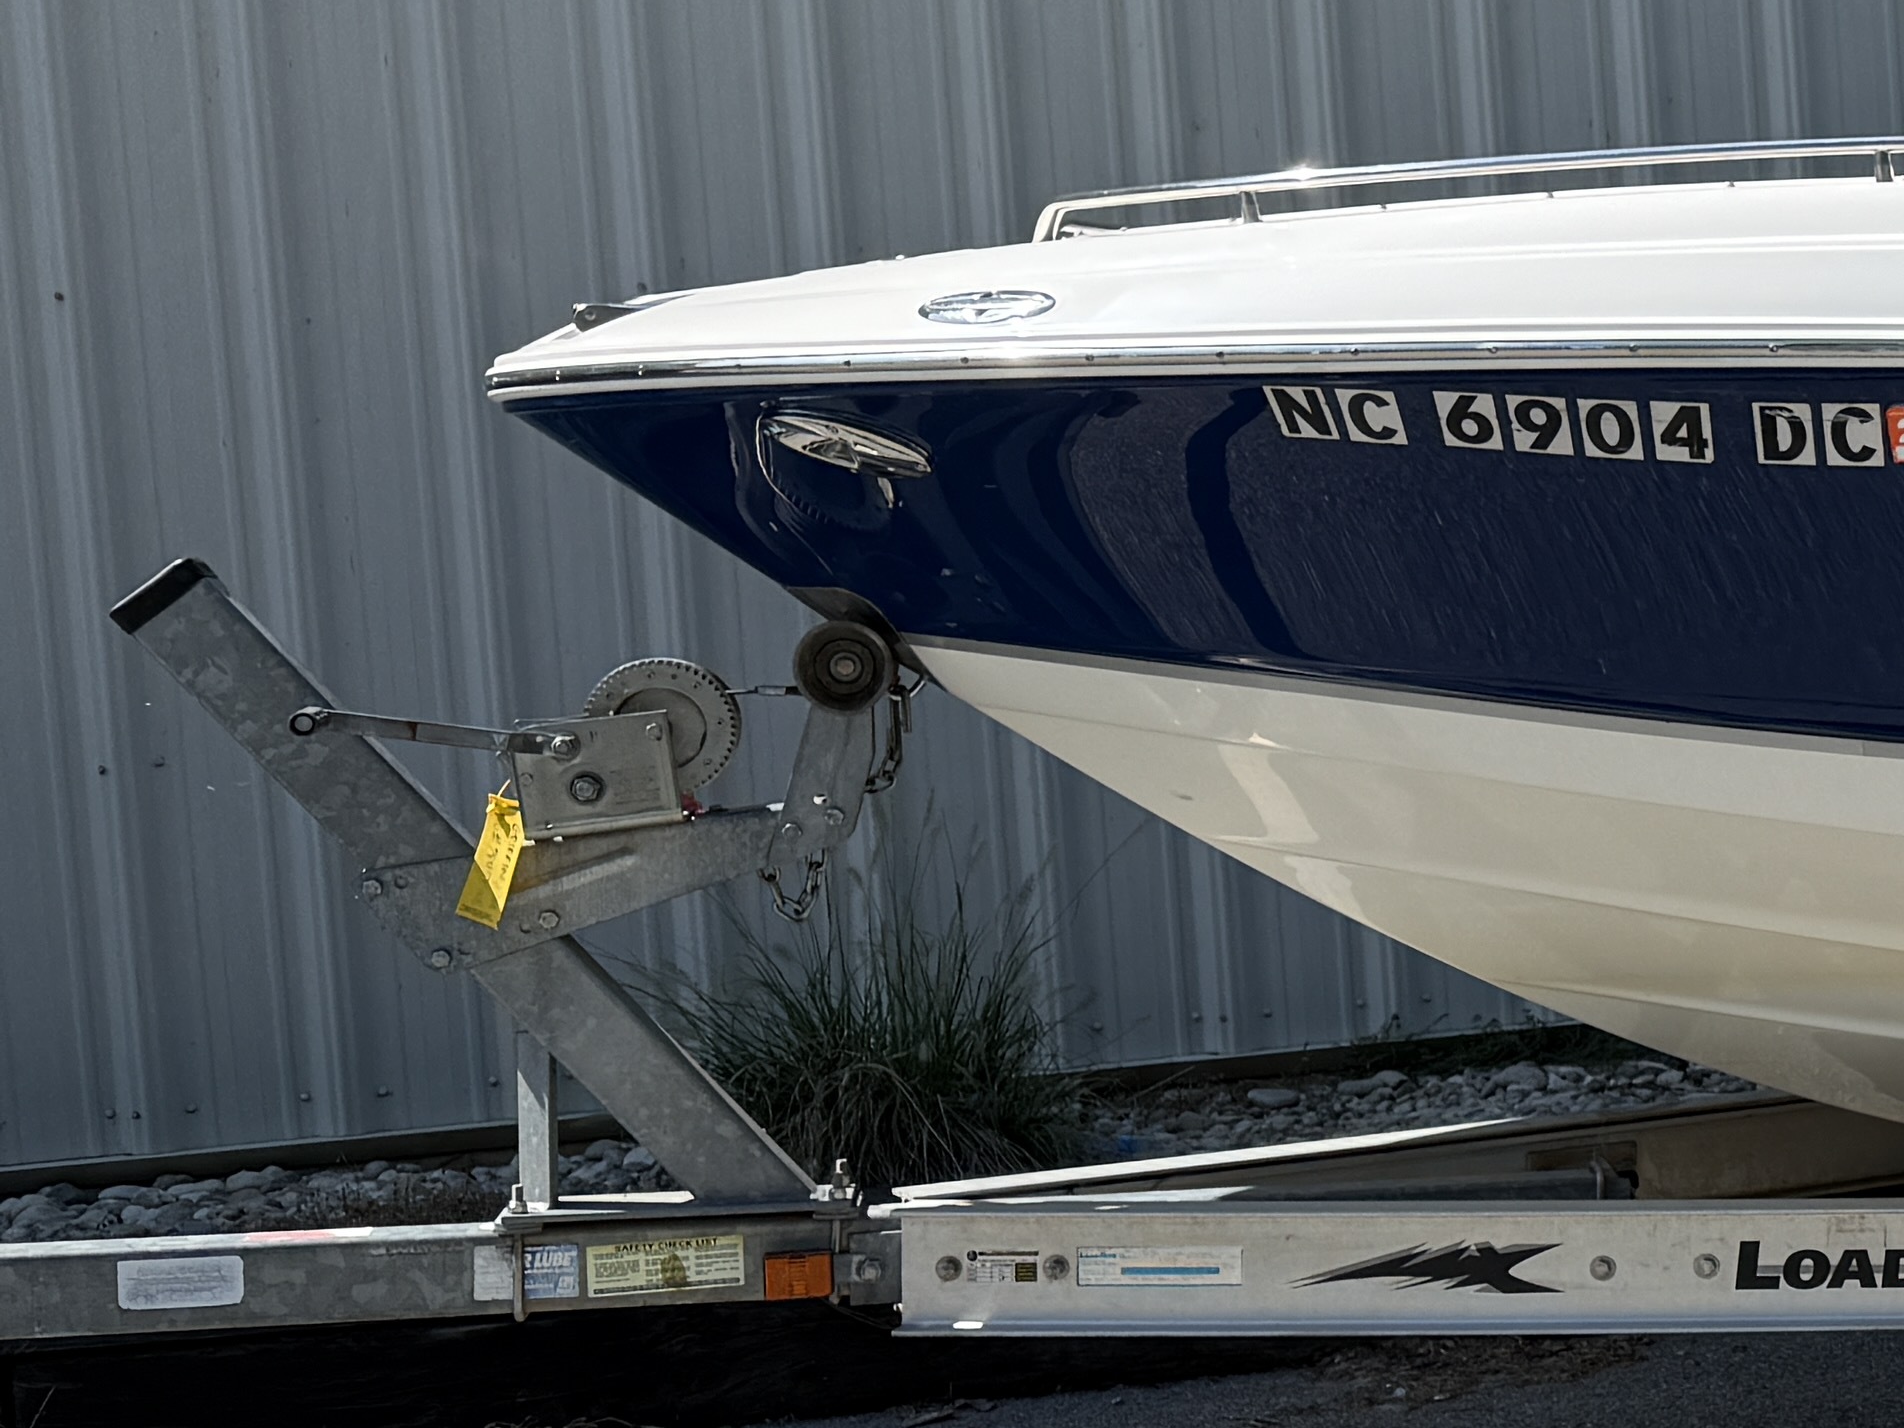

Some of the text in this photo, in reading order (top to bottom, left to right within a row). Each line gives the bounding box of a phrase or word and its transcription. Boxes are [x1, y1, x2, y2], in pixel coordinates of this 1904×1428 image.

[1270, 387, 1878, 463] NC 6904 DC
[533, 1251, 571, 1269] LUBE
